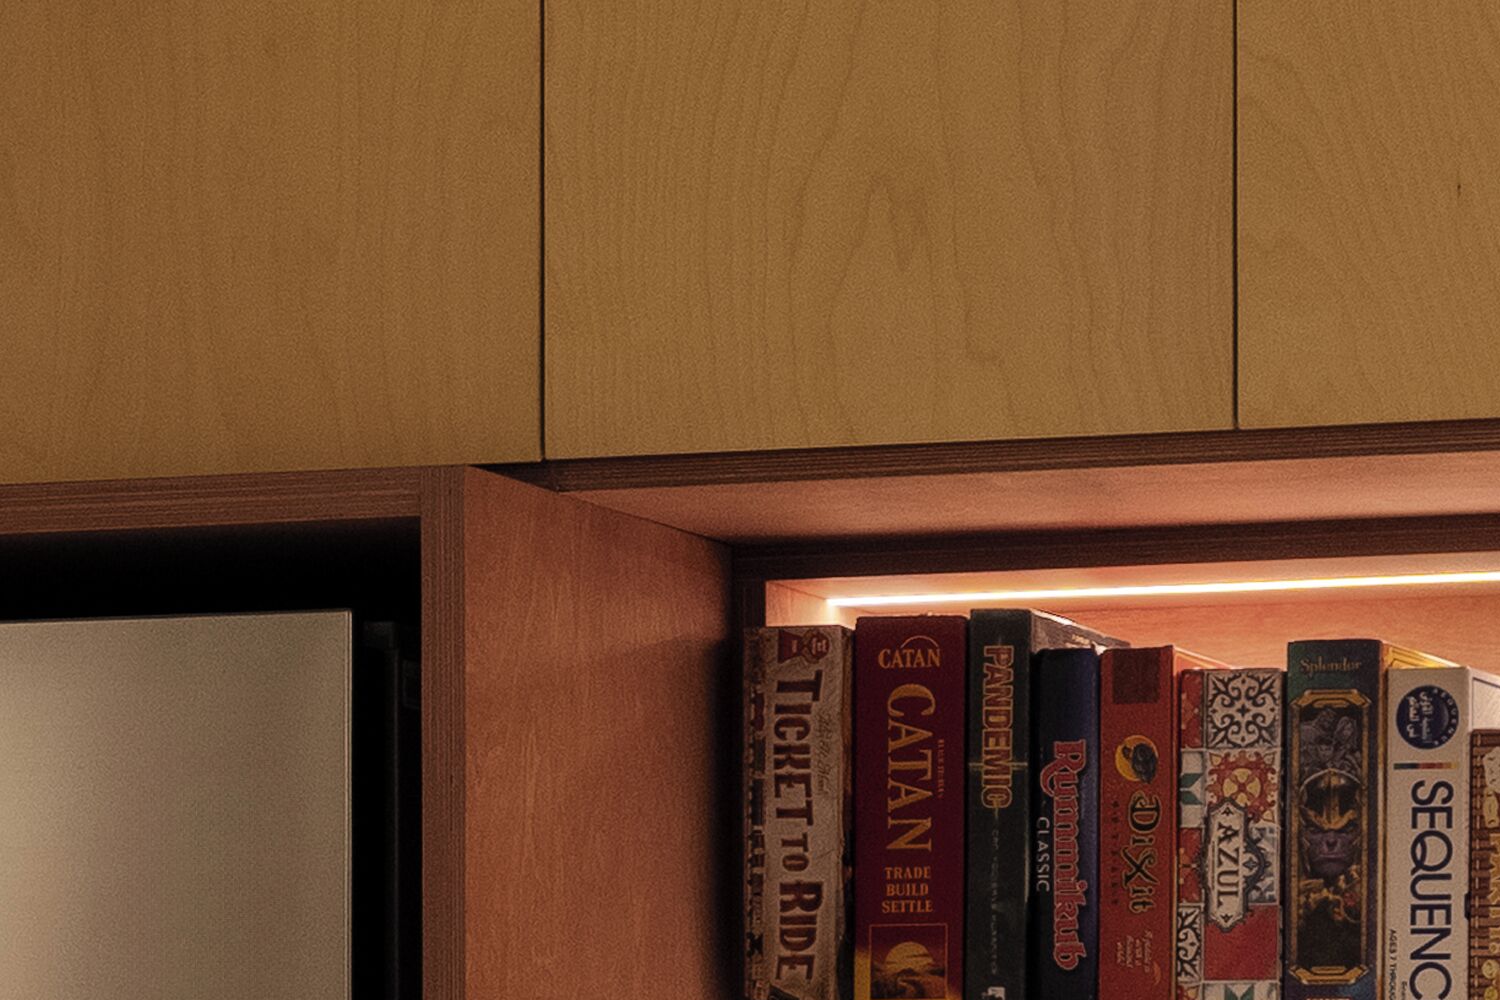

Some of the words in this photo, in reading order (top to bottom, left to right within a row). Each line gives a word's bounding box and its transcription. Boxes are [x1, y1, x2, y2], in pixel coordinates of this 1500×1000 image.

[878, 649, 941, 669] CATAN
[1300, 655, 1362, 678] Splendor
[773, 669, 824, 826] TICKET
[981, 645, 1015, 809] PANDEMIC
[886, 684, 936, 852] CATAN
[780, 832, 810, 872] TO
[885, 867, 931, 879] TRADE
[1036, 816, 1050, 892] CLASSIC
[1040, 738, 1088, 970] Rummikub
[1216, 822, 1240, 908] AZUL
[882, 900, 933, 913] SETTLE
[887, 884, 929, 897] BUILD
[776, 881, 824, 981] RIDE
